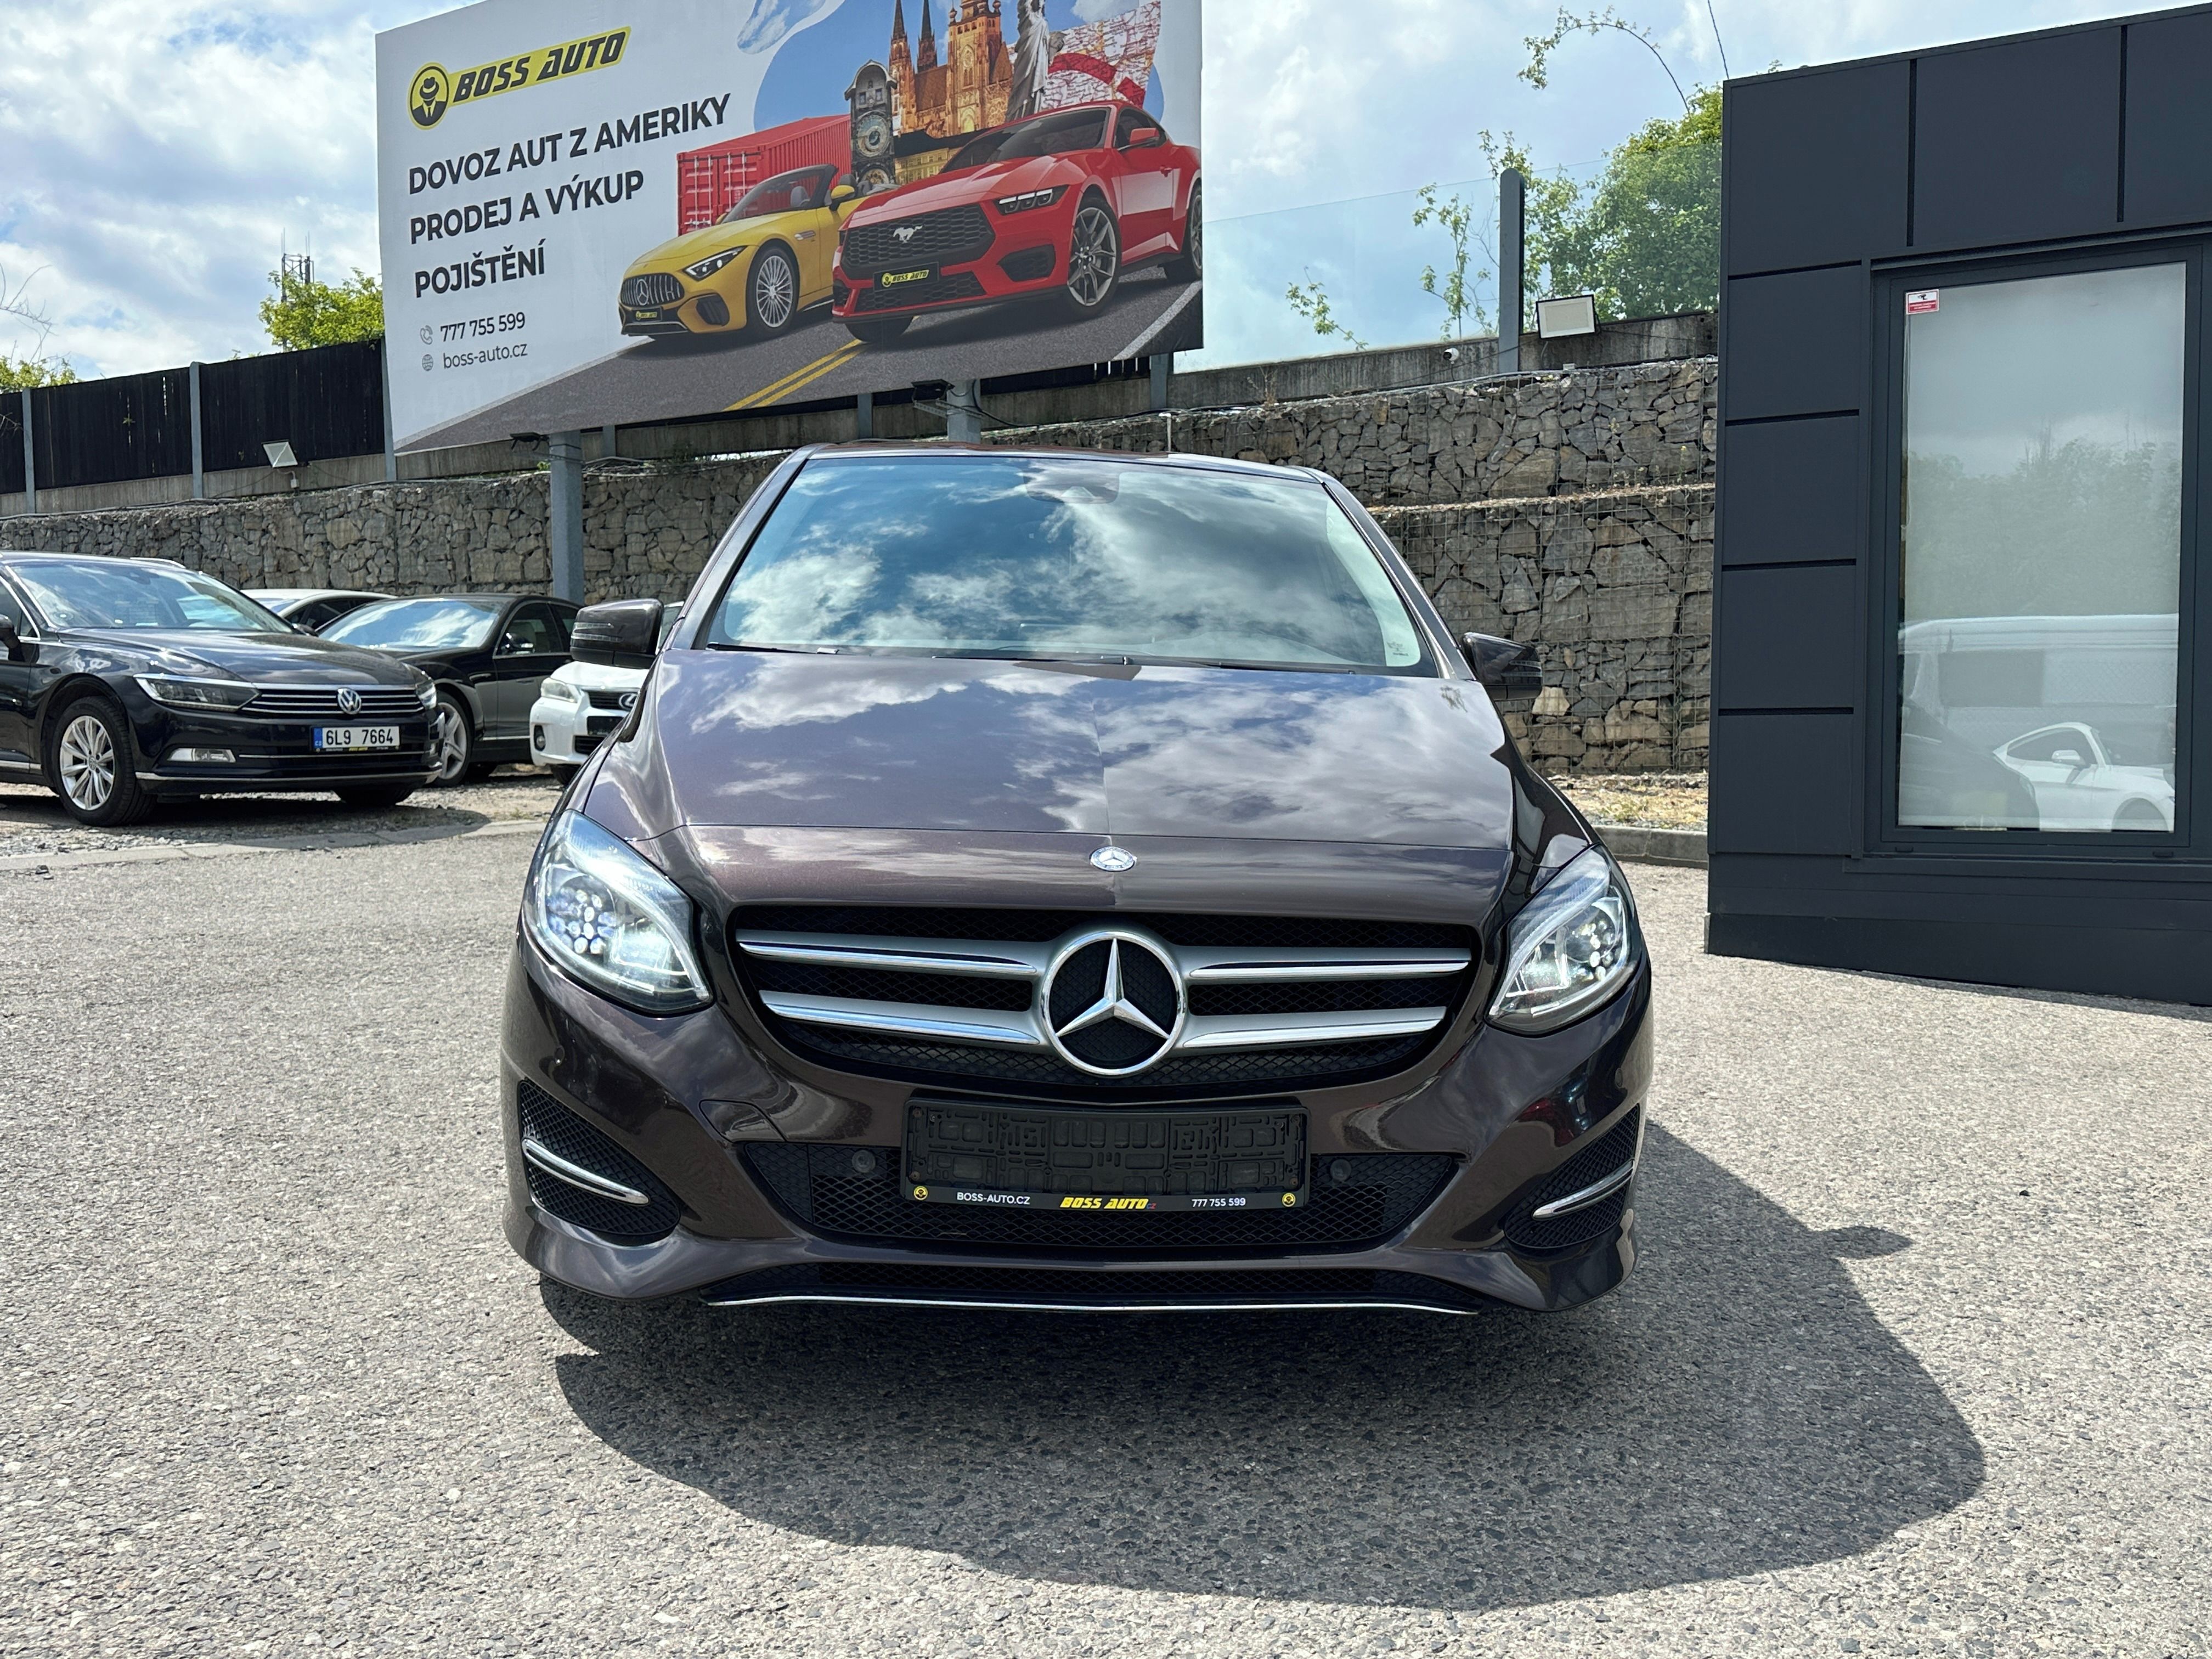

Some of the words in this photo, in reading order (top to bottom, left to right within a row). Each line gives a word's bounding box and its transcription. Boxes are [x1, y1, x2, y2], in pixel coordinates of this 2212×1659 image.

[453, 57, 531, 103] BOSS
[536, 31, 626, 81] AUTO
[409, 149, 501, 195] DOVOZ
[506, 133, 562, 172] AUT
[569, 127, 587, 157] Z
[594, 93, 731, 153] AMERIKY
[410, 192, 512, 244] PRODEJ
[519, 193, 540, 221] A
[545, 170, 644, 213] VÝKUP
[415, 239, 545, 297] POJIŠTĚNÍ
[440, 322, 466, 342] 777
[469, 317, 495, 337] 755
[499, 312, 525, 332] 599
[443, 343, 528, 369] boss-auto.cz
[326, 730, 351, 745] 6L9
[362, 729, 393, 744] 7664
[957, 1192, 1030, 1205] BOSS-AUTO.CZ
[1059, 1197, 1102, 1209] BOSS
[1104, 1198, 1149, 1209] AUTO
[1192, 1199, 1207, 1207] 777
[1209, 1198, 1226, 1207] 755
[1228, 1198, 1246, 1206] 599
